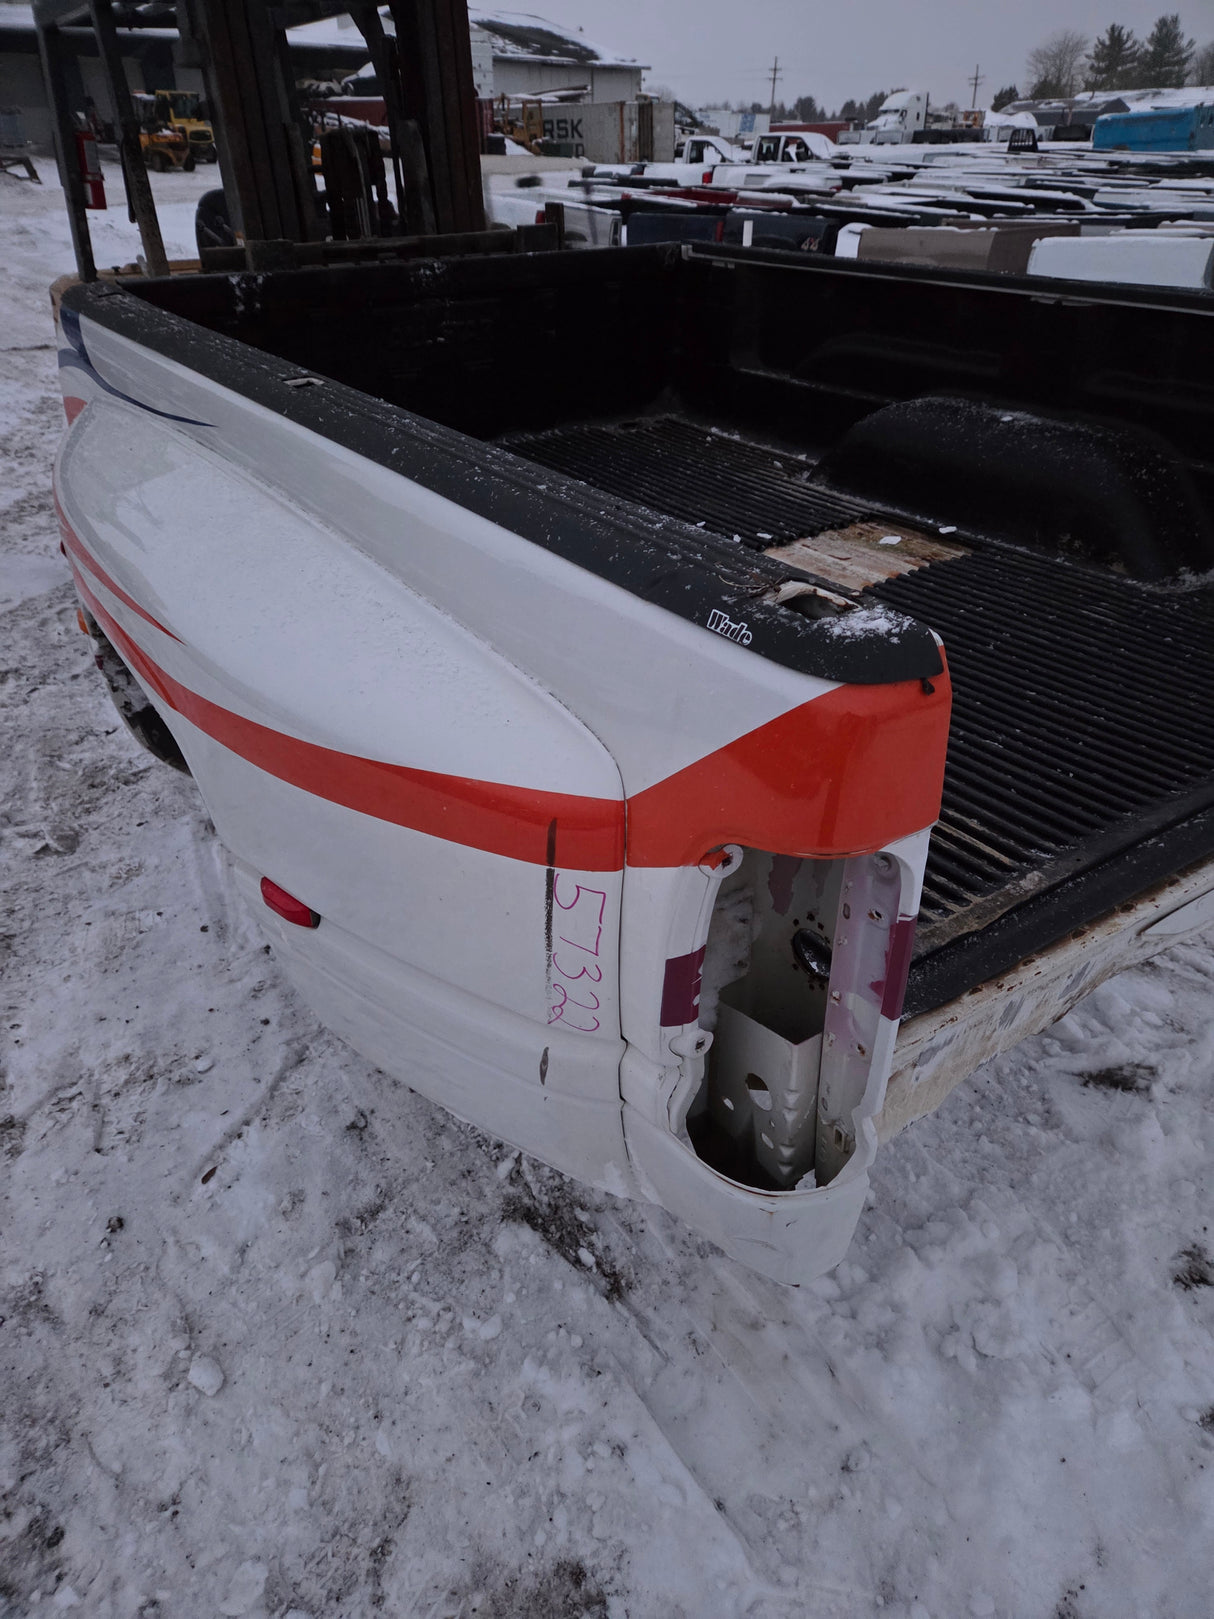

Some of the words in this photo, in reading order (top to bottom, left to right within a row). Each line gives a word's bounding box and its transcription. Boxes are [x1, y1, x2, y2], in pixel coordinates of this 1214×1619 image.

[543, 118, 583, 139] RSK
[706, 608, 753, 646] Wade
[547, 873, 606, 1032] 57322
